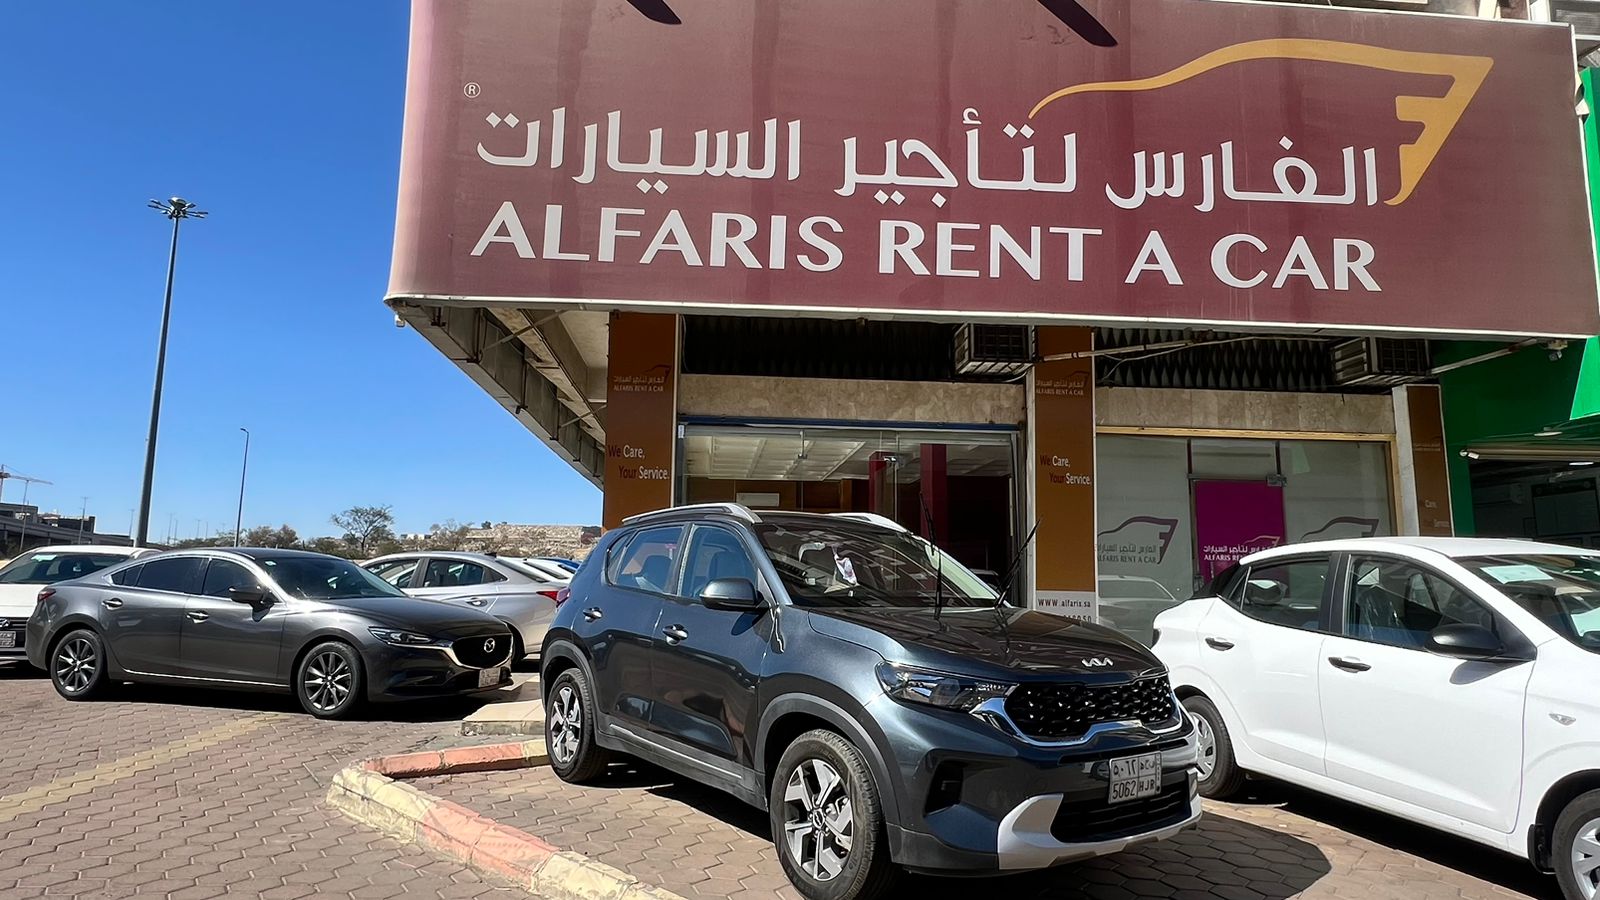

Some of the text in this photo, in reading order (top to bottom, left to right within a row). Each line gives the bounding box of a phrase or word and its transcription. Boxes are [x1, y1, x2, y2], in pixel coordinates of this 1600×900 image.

[477, 106, 1378, 212] الفارس لتأجير السيارات
[470, 201, 1382, 292] ALFARIS RENT A CAR
[607, 444, 645, 459] We Care,
[1040, 455, 1070, 468] We Care,
[618, 465, 637, 479] Your
[1049, 472, 1065, 483] Your
[1112, 779, 1155, 800] 5062 HJR
